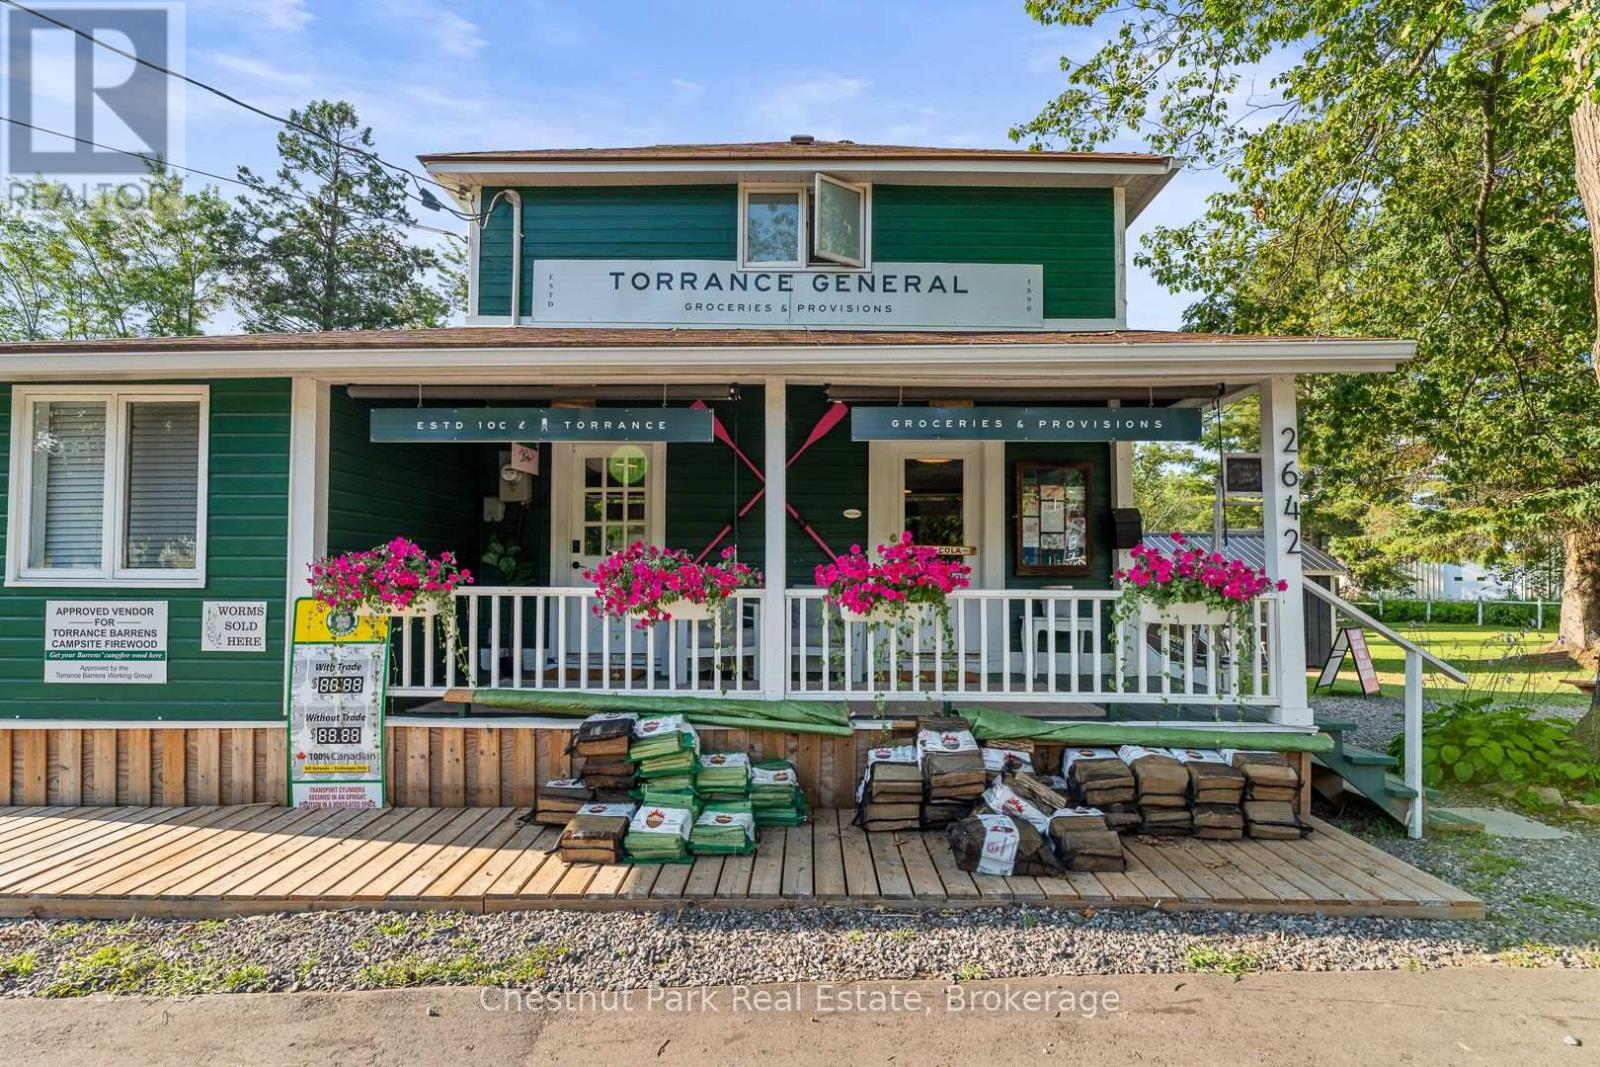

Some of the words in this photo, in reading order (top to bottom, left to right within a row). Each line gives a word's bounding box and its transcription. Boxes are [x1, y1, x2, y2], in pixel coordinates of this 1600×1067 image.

[609, 272, 794, 292] TORRANCE
[812, 274, 968, 294] GENERAL
[685, 303, 772, 312] GROCERIES
[781, 304, 788, 312] &
[797, 304, 893, 313] PROVISIONS
[417, 422, 464, 430] ESTD
[564, 421, 667, 430] TORRANCE
[891, 420, 1003, 428] GROCERIES
[1016, 420, 1024, 428] &
[1039, 420, 1163, 429] PROVISIONS
[56, 607, 110, 616] APPROVED
[112, 607, 154, 616] VENDOR
[218, 606, 264, 616] WORMS
[94, 618, 115, 626] FOR
[224, 621, 258, 630] SOLD
[52, 629, 107, 638] TORRANCE
[110, 629, 158, 638] BARRENS
[52, 640, 102, 648] CAMPSITE
[104, 640, 158, 648] FIREWOOD
[227, 637, 262, 646] HERE
[104, 652, 130, 660] campfire
[316, 664, 336, 672] With
[108, 672, 132, 680] Working
[306, 714, 340, 722] Without
[342, 713, 366, 722] Trade
[331, 752, 376, 760] Canadian
